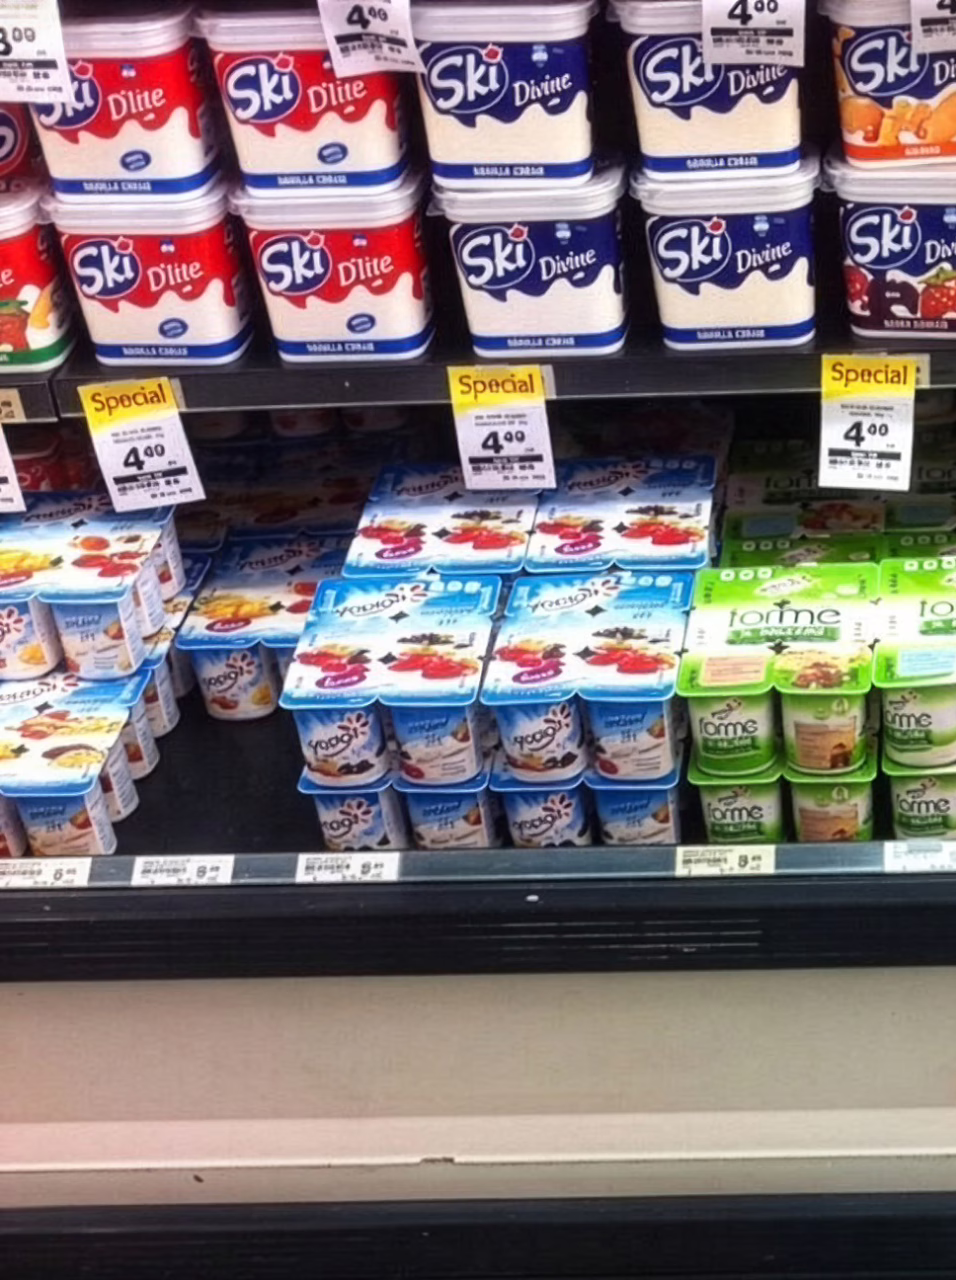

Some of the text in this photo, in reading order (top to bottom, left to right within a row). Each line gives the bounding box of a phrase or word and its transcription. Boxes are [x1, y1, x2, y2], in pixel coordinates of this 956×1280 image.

[227, 62, 293, 119] Ski
[429, 50, 499, 110] Ski
[513, 73, 572, 107] Divine
[462, 233, 527, 286] Ski
[539, 247, 596, 281] Divine
[657, 228, 722, 280] Ski
[735, 241, 792, 274] Divine
[851, 215, 912, 264] Ski
[74, 247, 134, 296] Ski
[261, 243, 322, 294] Ski
[459, 374, 535, 399] Special
[832, 362, 908, 387] Special
[91, 383, 167, 416] Special
